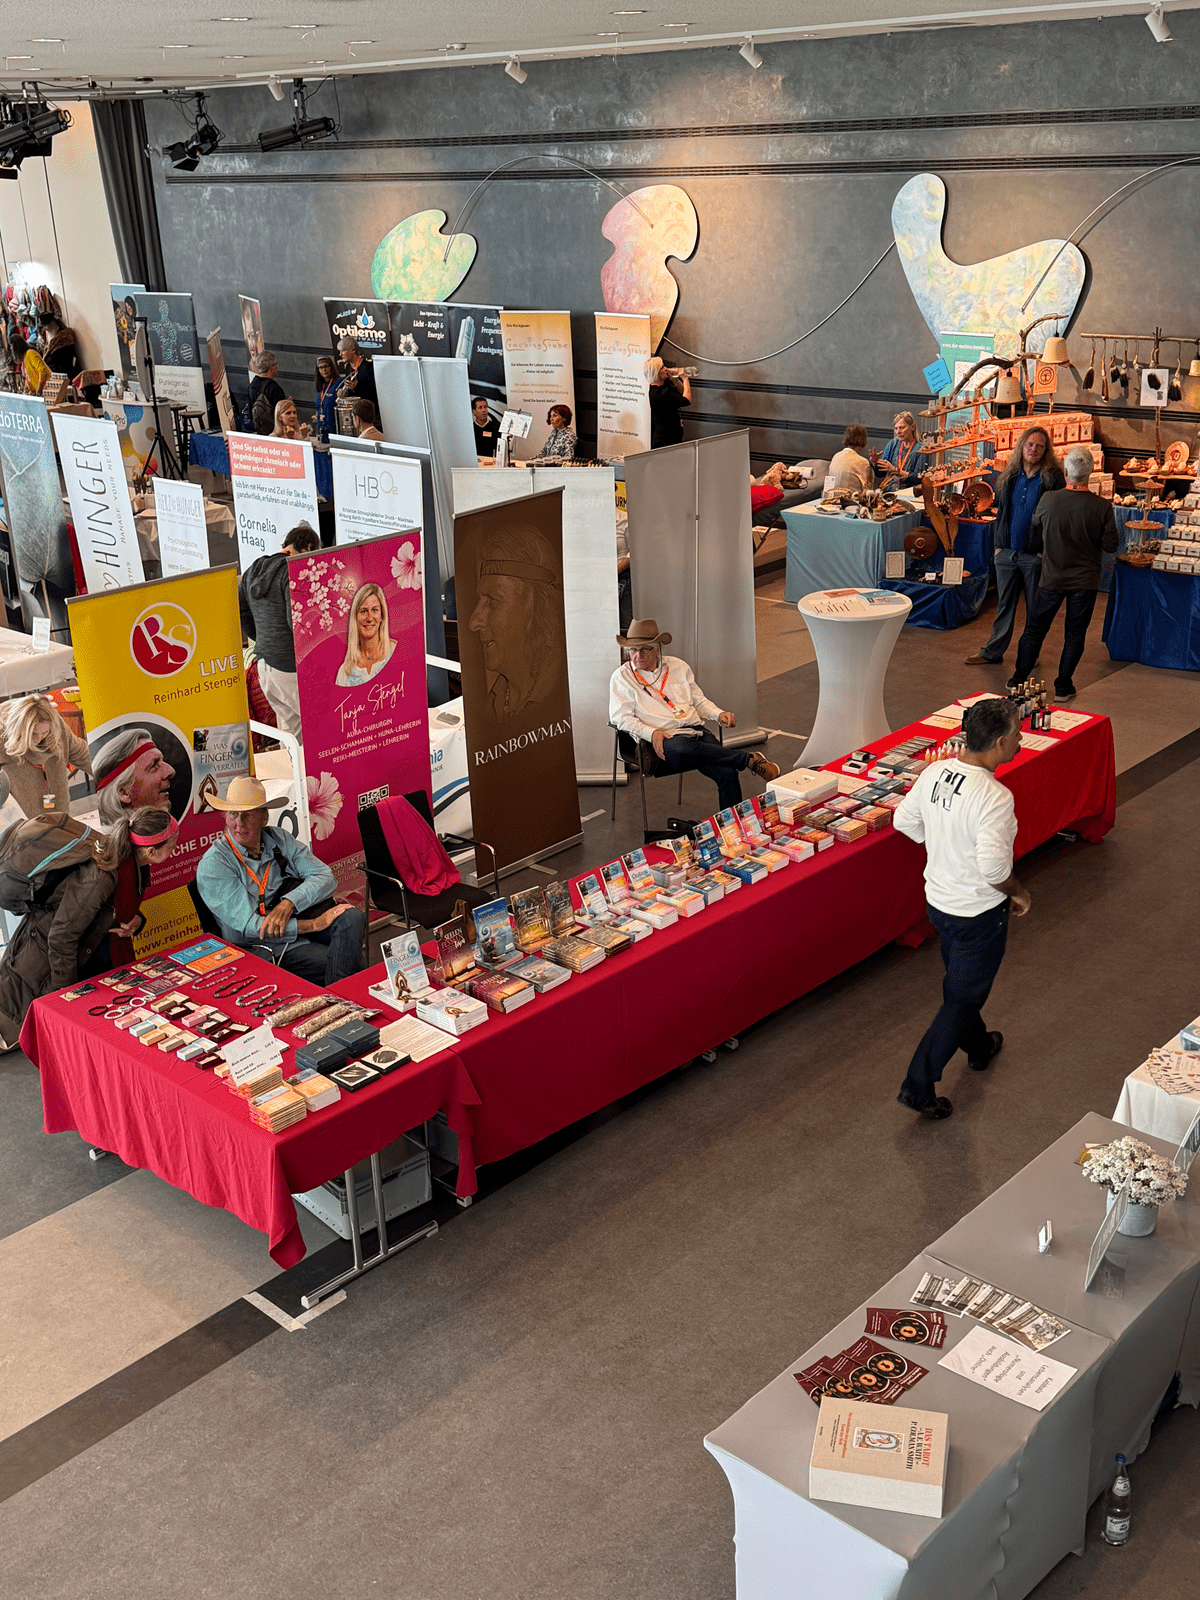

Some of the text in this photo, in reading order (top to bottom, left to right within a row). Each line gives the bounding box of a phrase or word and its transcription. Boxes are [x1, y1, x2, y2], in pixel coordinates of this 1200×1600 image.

[332, 324, 386, 339] Optilemo
[232, 442, 243, 451] Sind
[253, 445, 268, 454] selbst
[269, 447, 281, 456] oder
[233, 452, 301, 468] Angehöriger chronisch oder
[234, 462, 276, 474] schwer erkrankt?
[103, 438, 127, 544] MANAGE YOUR NEEDS
[72, 441, 120, 568] HUNGER
[176, 496, 202, 518] HUNGER
[240, 514, 276, 534] Cornelia
[241, 530, 265, 551] Haag
[200, 654, 239, 677] LIVE
[153, 673, 241, 704] Reinhard Stengel
[334, 671, 405, 732] Tanja Stengel
[318, 719, 422, 758] SEELEN-SCHAMANIN HUNA-LEHRERIN
[347, 718, 393, 738] AURA-CHIRURGIN
[333, 733, 410, 763] REIKI-MEISTERIN LEHRERIN
[474, 717, 571, 766] RAINBOWMAN
[200, 752, 234, 765] FINGER
[213, 761, 246, 772] VERRATEN
[168, 836, 201, 858] CHE
[330, 854, 362, 871] ONTAKT
[985, 1345, 997, 1356] auch
[1016, 1371, 1026, 1381] und
[1016, 1364, 1048, 1396] Lebensanalysen
[1035, 1377, 1053, 1394] Kabbala
[907, 1426, 916, 1450] COLMAN
[921, 1427, 932, 1467] DAS TAROT
[905, 1450, 914, 1469] SMITH
